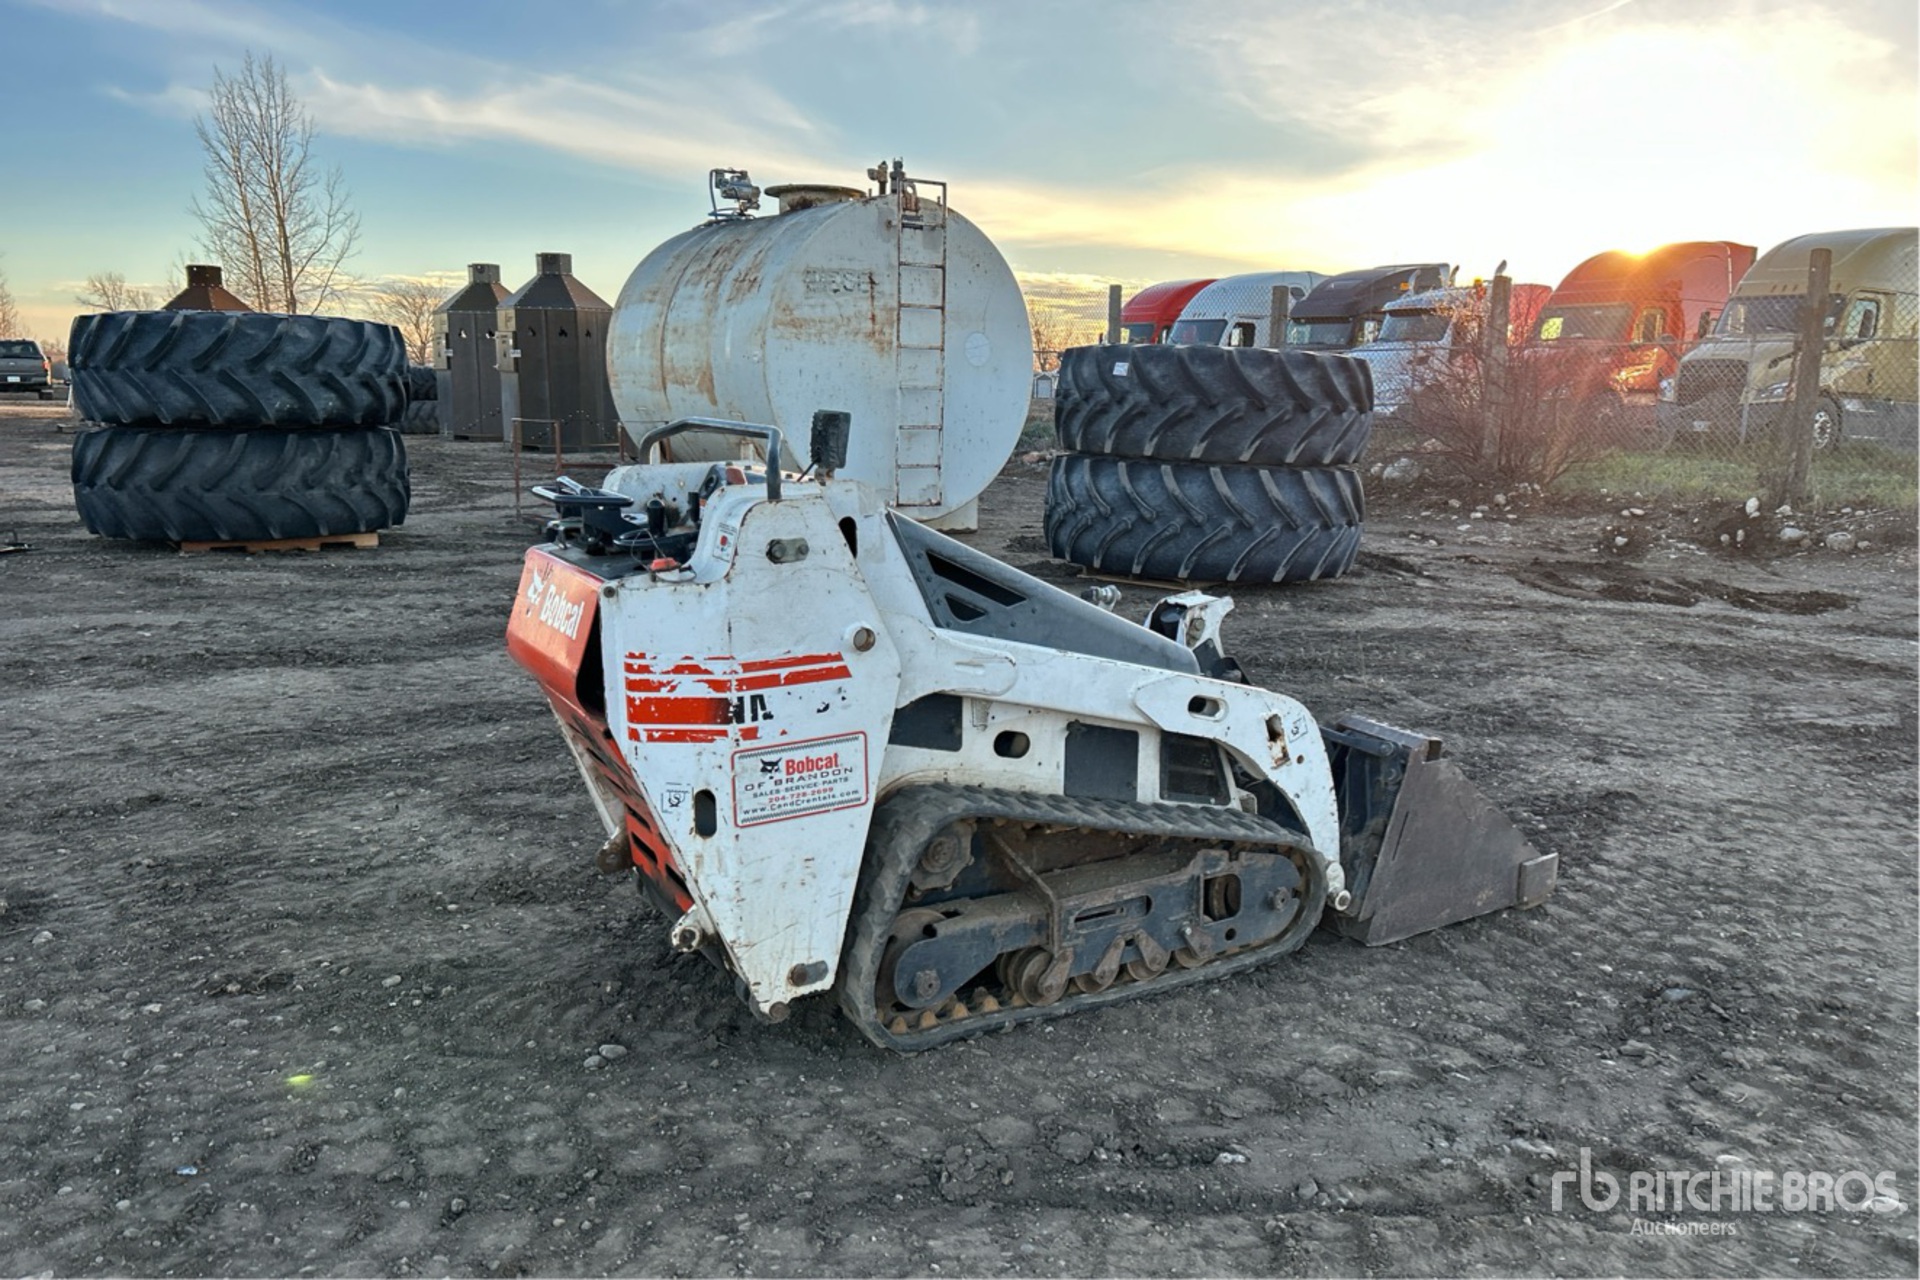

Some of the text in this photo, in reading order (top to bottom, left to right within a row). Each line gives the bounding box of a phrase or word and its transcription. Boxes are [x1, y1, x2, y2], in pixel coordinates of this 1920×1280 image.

[785, 753, 838, 775] Bobcat
[744, 767, 853, 792] OF BRANDON
